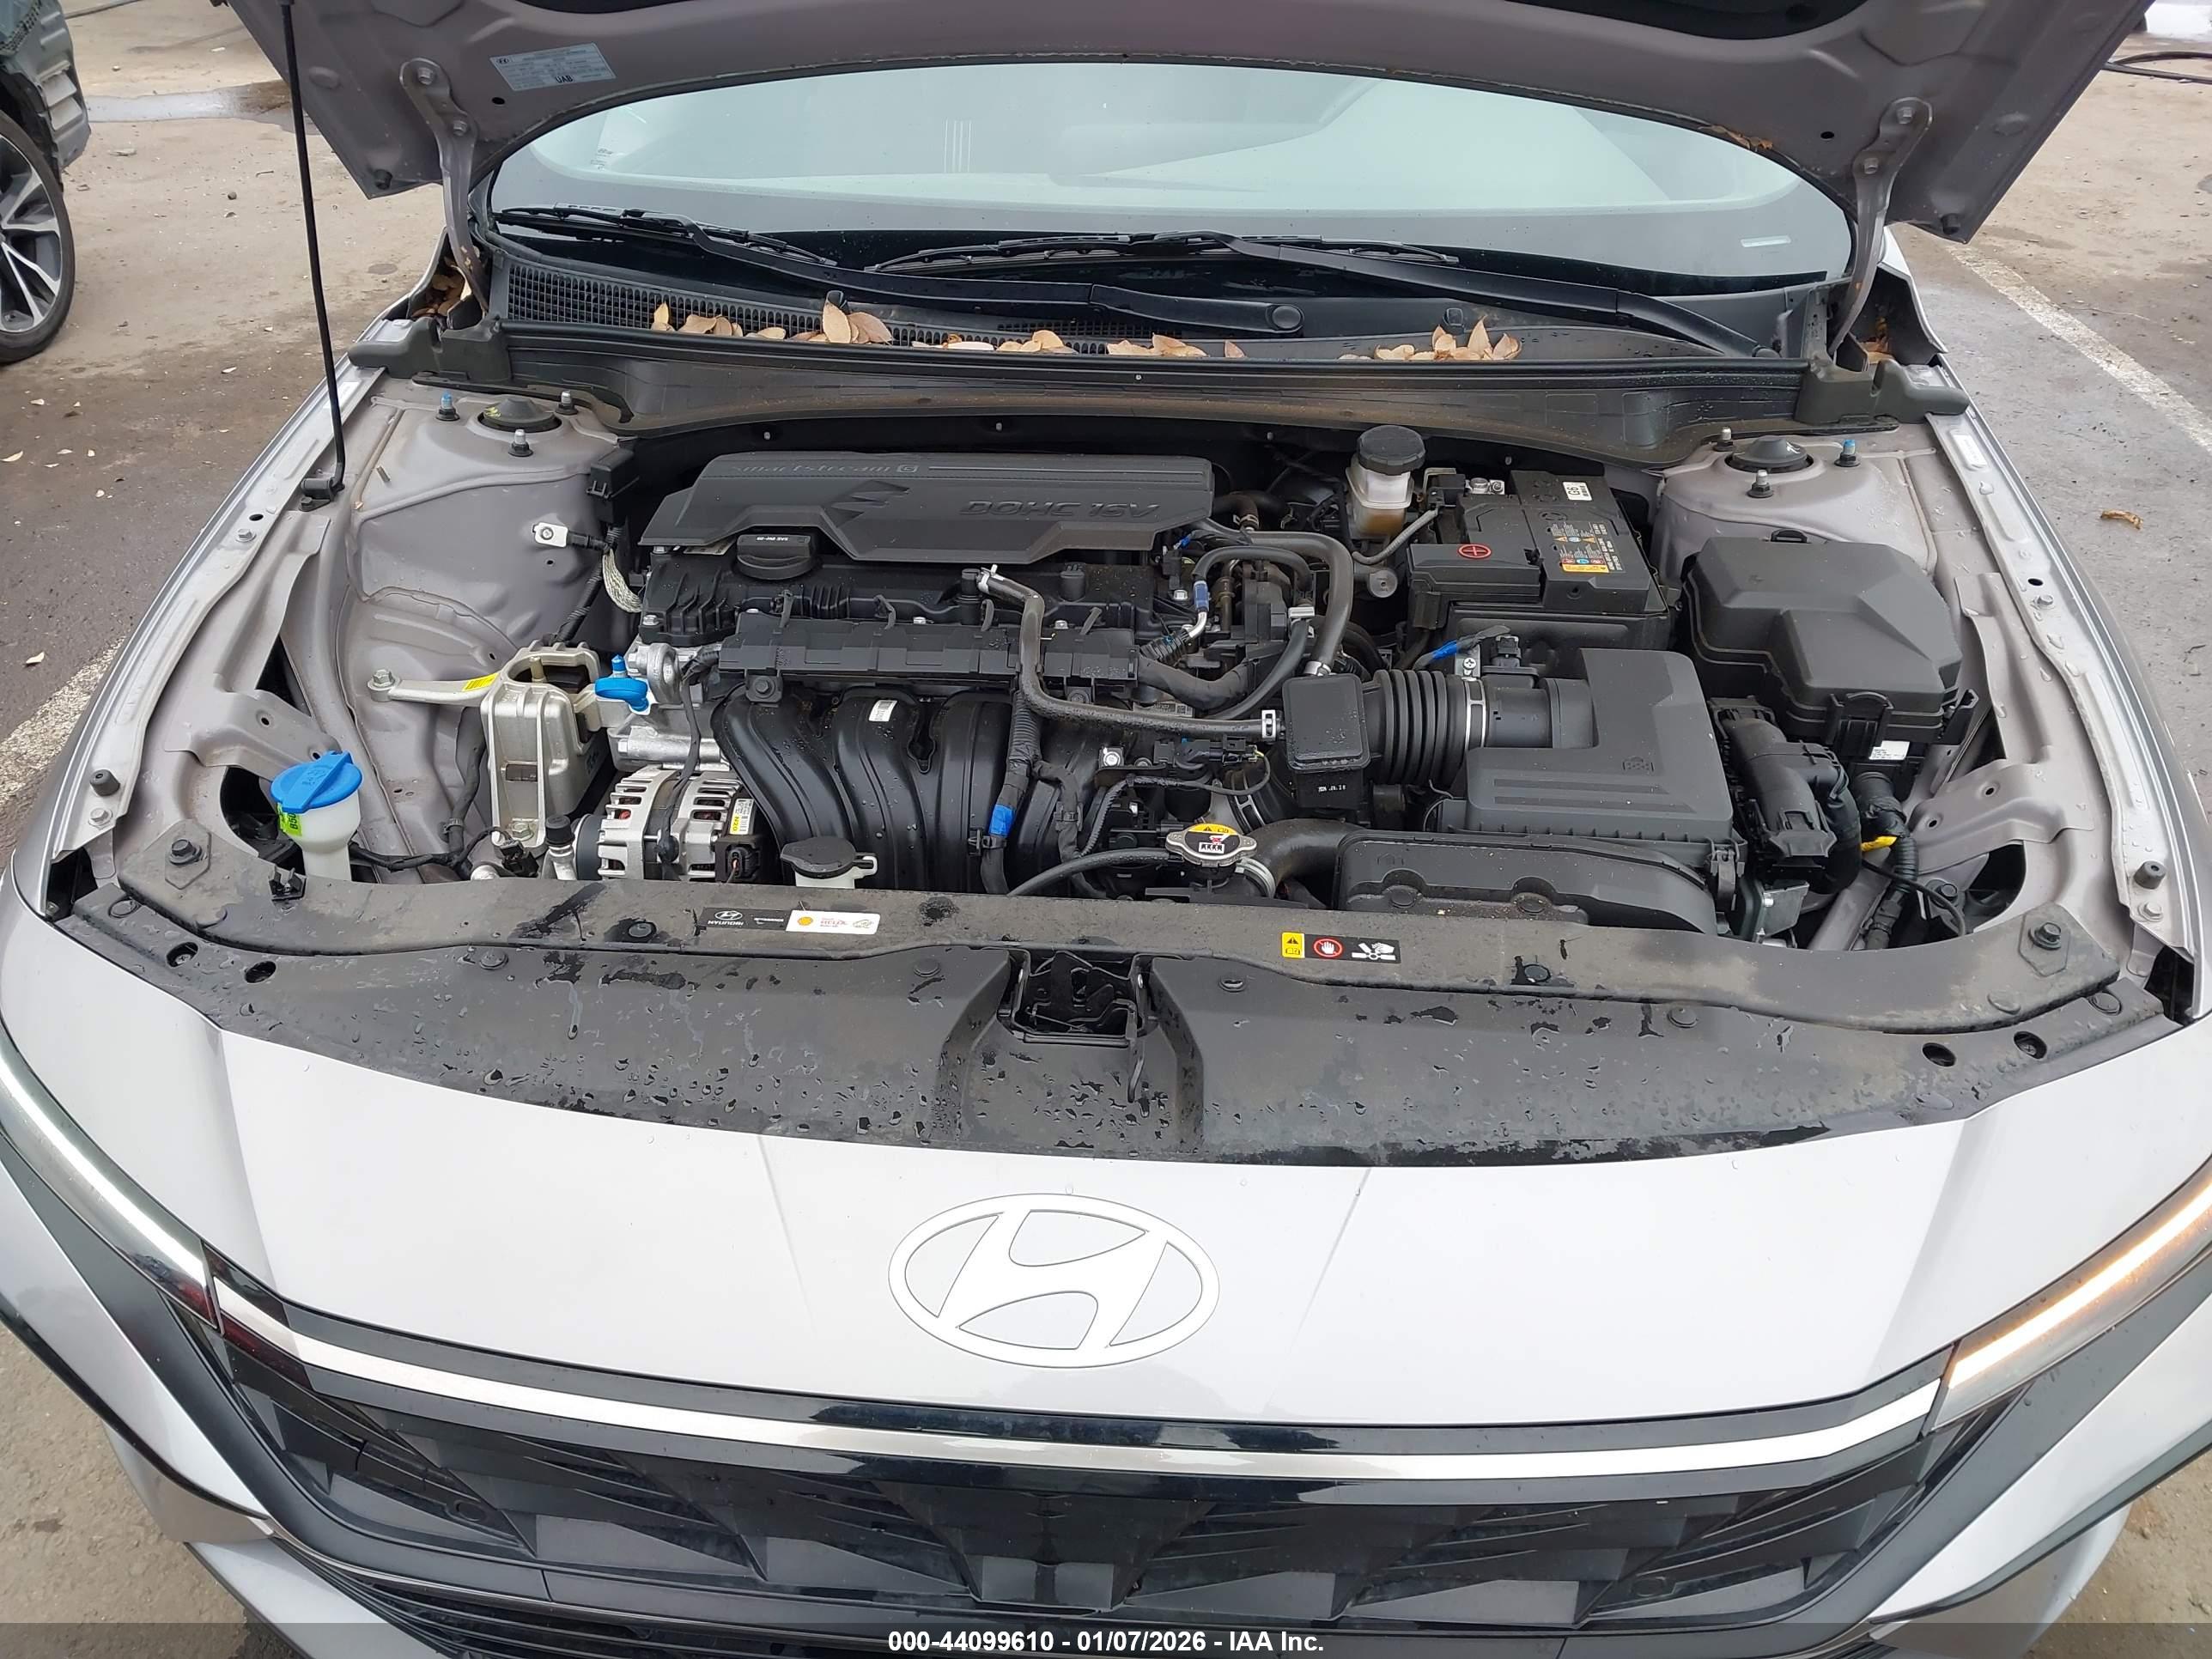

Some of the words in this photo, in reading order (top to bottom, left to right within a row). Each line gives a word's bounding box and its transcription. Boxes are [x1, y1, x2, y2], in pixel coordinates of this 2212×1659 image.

[555, 75, 574, 84] UAB
[960, 501, 1081, 515] DOHC
[1089, 503, 1160, 517] 16V
